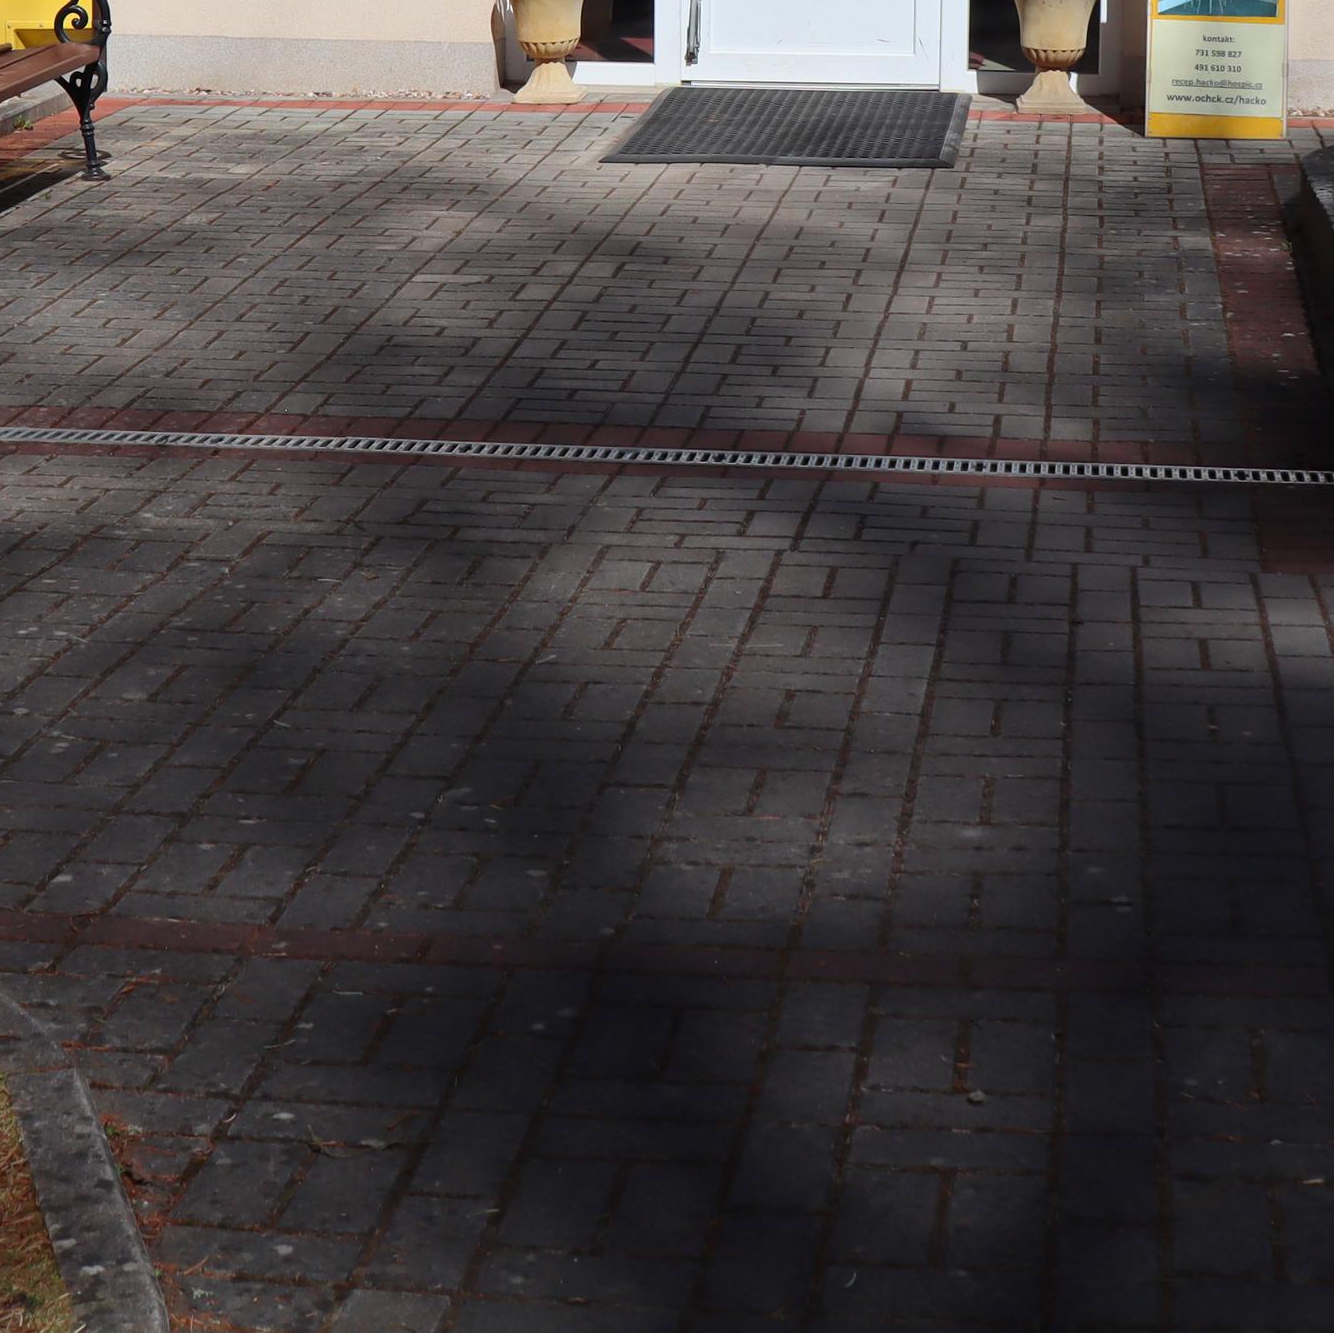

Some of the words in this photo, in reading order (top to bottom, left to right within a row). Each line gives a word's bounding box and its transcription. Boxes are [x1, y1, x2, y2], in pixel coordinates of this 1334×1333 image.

[1202, 35, 1236, 43] kontakt:
[1195, 49, 1209, 57] 731
[1211, 49, 1226, 58] 598
[1227, 50, 1242, 58] 827
[1194, 64, 1208, 72] 491
[1210, 64, 1225, 72] 610
[1227, 65, 1242, 73] 310
[1166, 94, 1267, 105] www.ochck.cz/hacko
